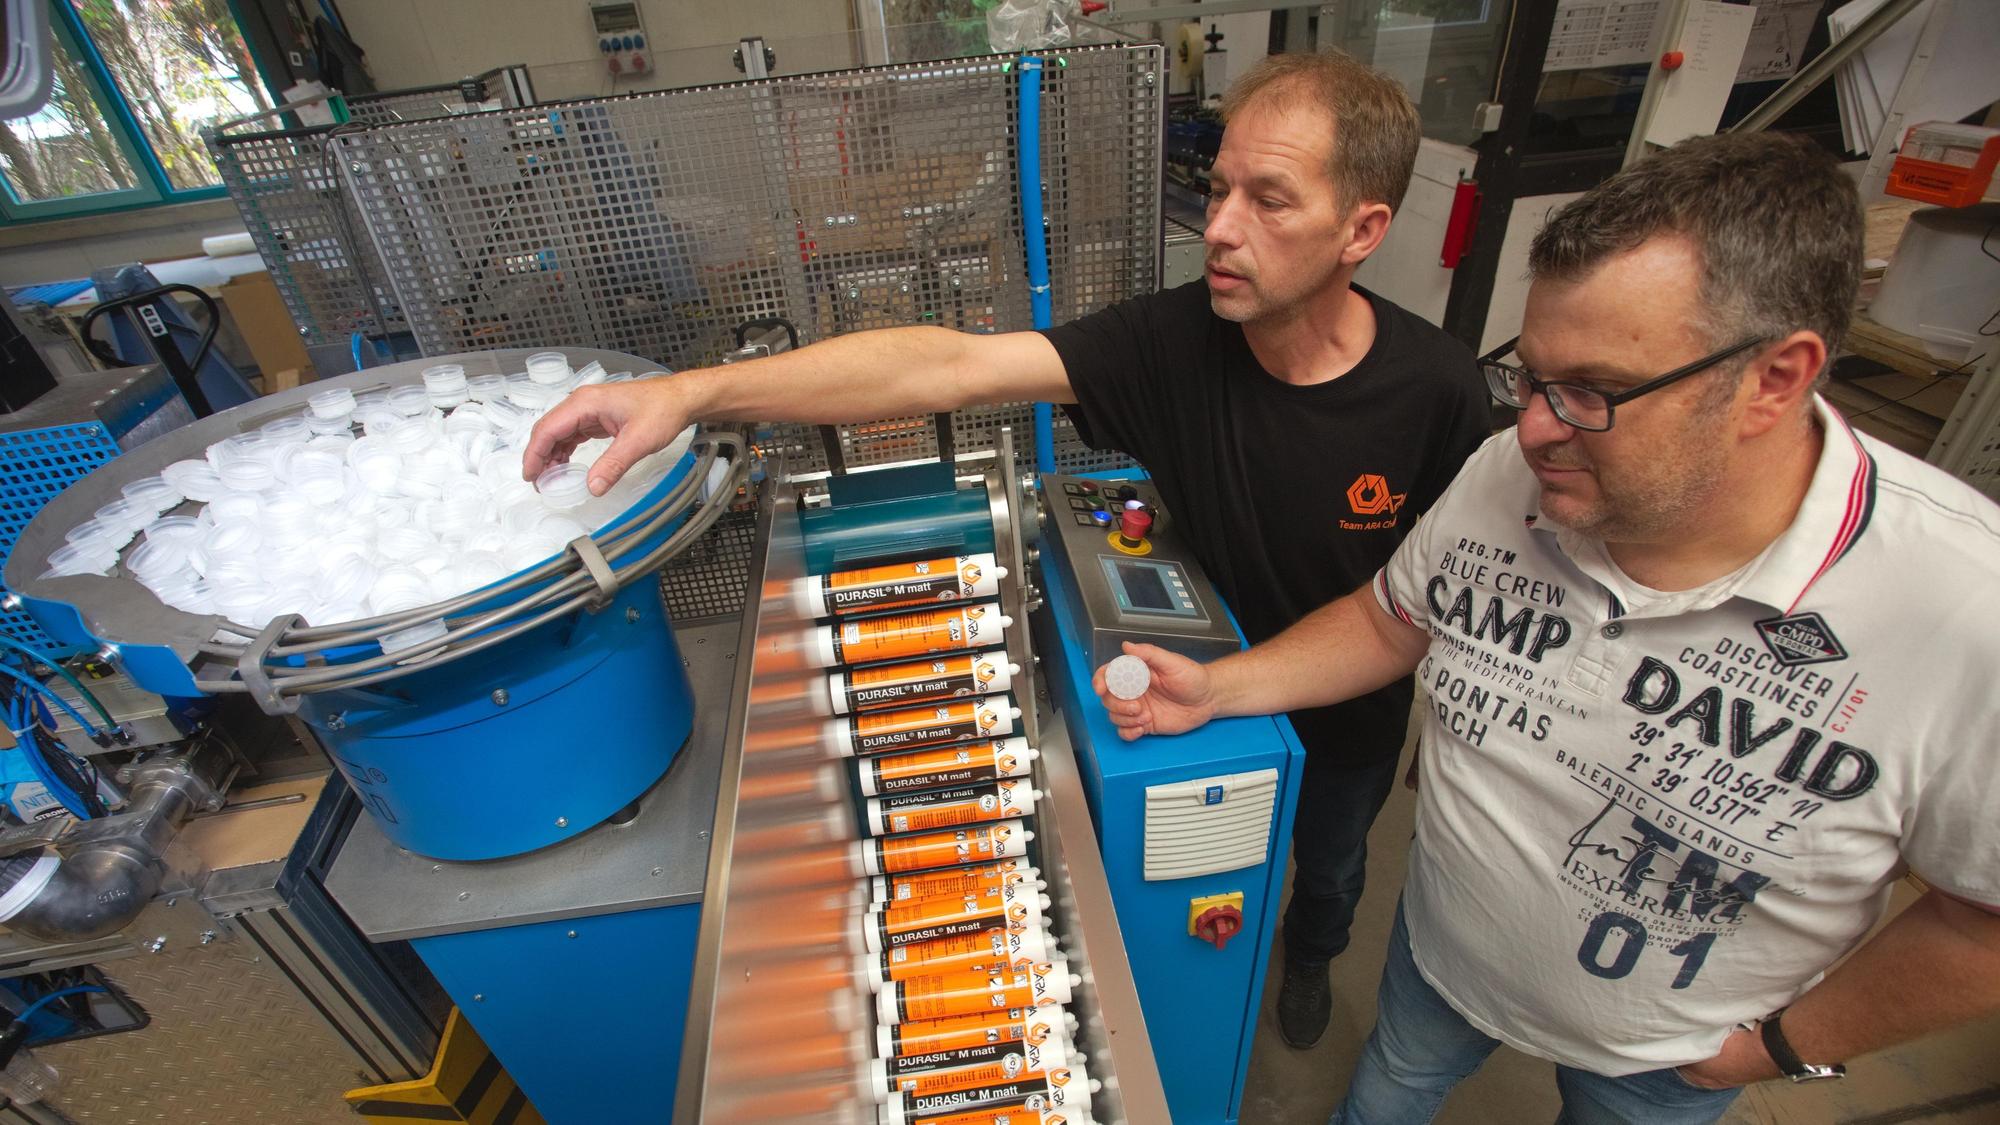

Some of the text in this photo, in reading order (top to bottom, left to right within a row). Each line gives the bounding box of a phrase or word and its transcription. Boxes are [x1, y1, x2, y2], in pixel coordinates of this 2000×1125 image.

[1339, 520, 1363, 530] Team
[1364, 522, 1381, 530] ARA
[1457, 537, 1517, 566] REG.TM
[894, 585, 906, 596] M
[907, 582, 931, 593] matt
[1440, 551, 1566, 607] BLUE CREW
[1426, 575, 1572, 663] CAMP
[1778, 624, 1824, 648] CMPD
[1433, 625, 1476, 656] SPANISH
[1479, 651, 1533, 680] ISLAND
[1542, 676, 1560, 690] IN
[1714, 637, 1833, 698] DISCOVER
[912, 684, 923, 693] M
[925, 681, 949, 692] matt
[1441, 644, 1588, 720] THE MEDITERRANEAN
[1678, 647, 1819, 719] COASTLINES
[917, 731, 927, 740] M
[929, 727, 951, 738] matt
[1622, 655, 1880, 801] DAVID
[938, 774, 948, 782] M
[950, 771, 972, 780] matt
[942, 791, 951, 799] M
[953, 788, 974, 797] matt
[1555, 750, 1756, 865] BALEARIC ISLANDS
[1765, 821, 1798, 842] E
[1557, 872, 1610, 907] IMPRESSIVE
[1568, 860, 1748, 927] EXPERIENCE
[946, 926, 957, 935] M
[958, 922, 981, 933] matt
[1576, 911, 1717, 989] 01
[958, 1048, 969, 1059] M
[971, 1046, 996, 1057] matt
[979, 1089, 991, 1100] M
[992, 1086, 1018, 1098] matt
